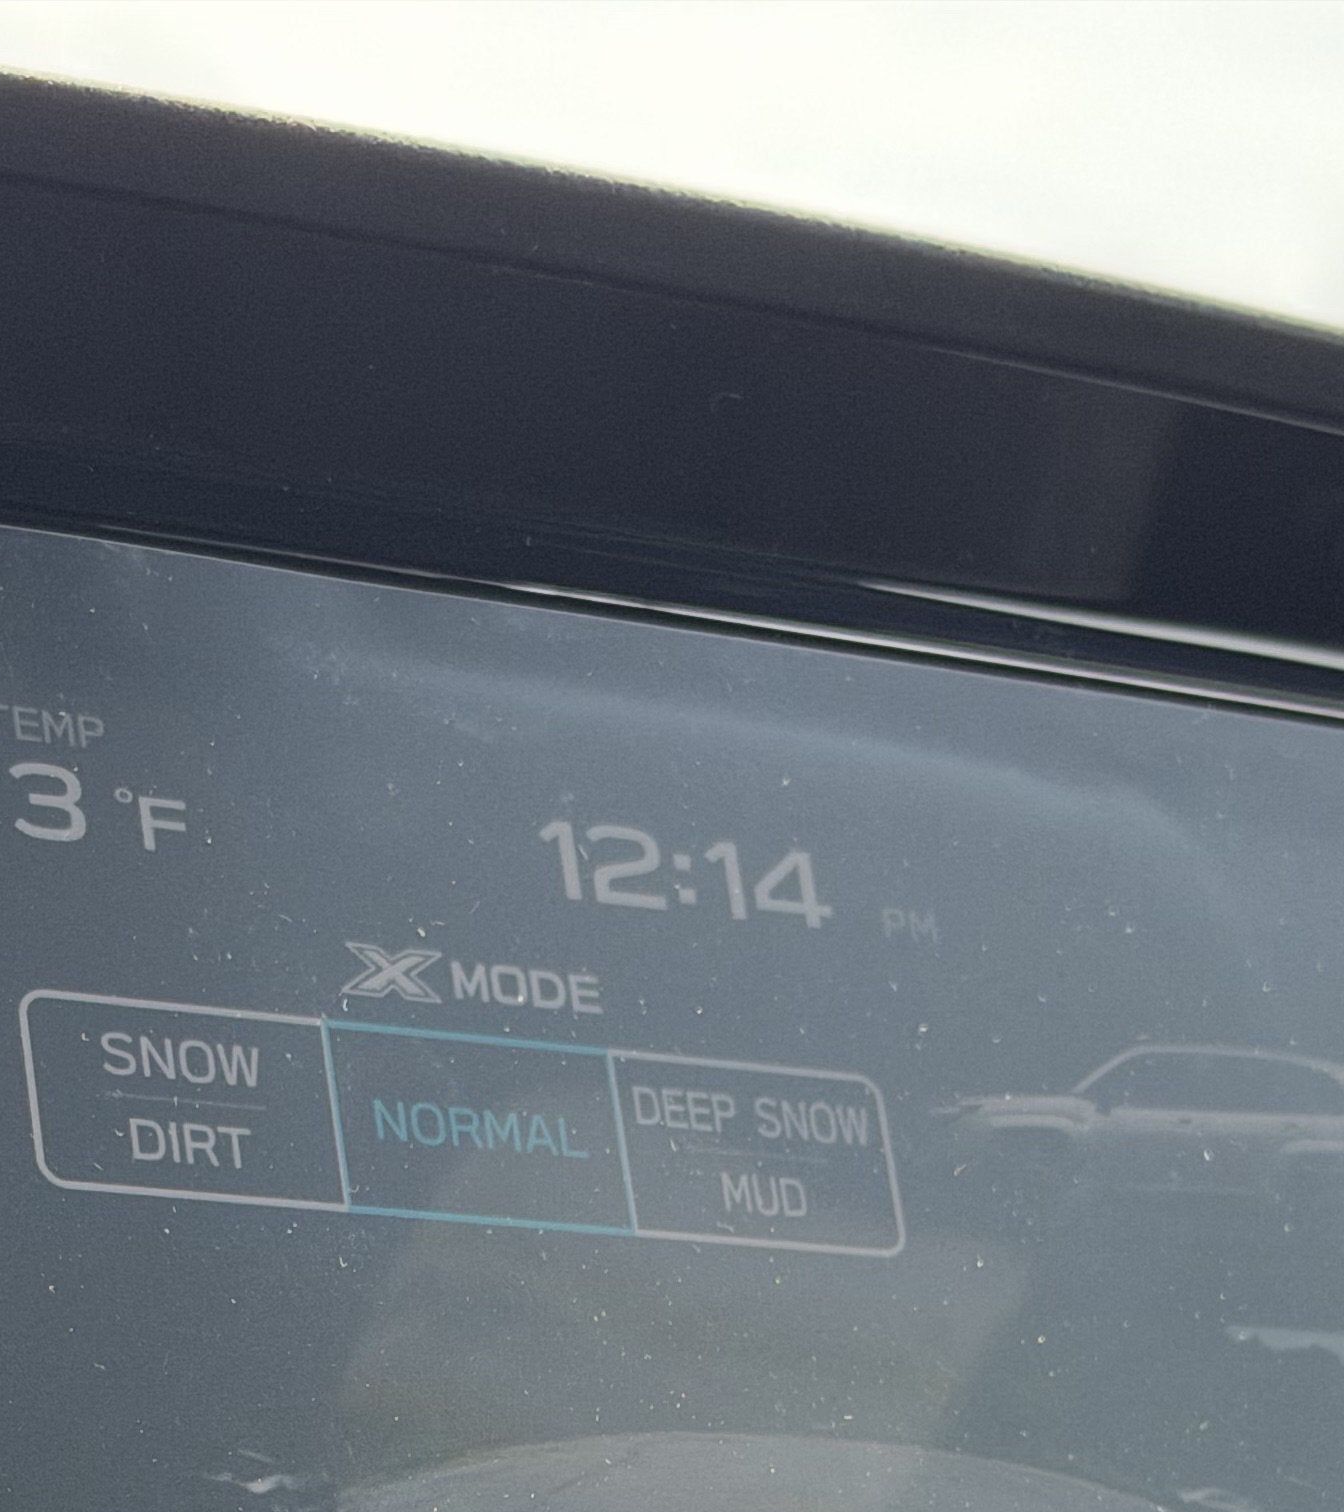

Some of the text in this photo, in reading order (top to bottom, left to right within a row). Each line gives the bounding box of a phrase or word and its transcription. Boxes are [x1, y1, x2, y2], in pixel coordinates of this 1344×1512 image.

[540, 820, 939, 943] 12:14 PM
[452, 961, 604, 1014] MODE
[101, 1032, 260, 1088] SNOW
[130, 1118, 252, 1169] DIRT
[372, 1099, 591, 1158] NORMAL
[633, 1086, 870, 1146] DEEP SNOW
[721, 1172, 808, 1217] MUD
